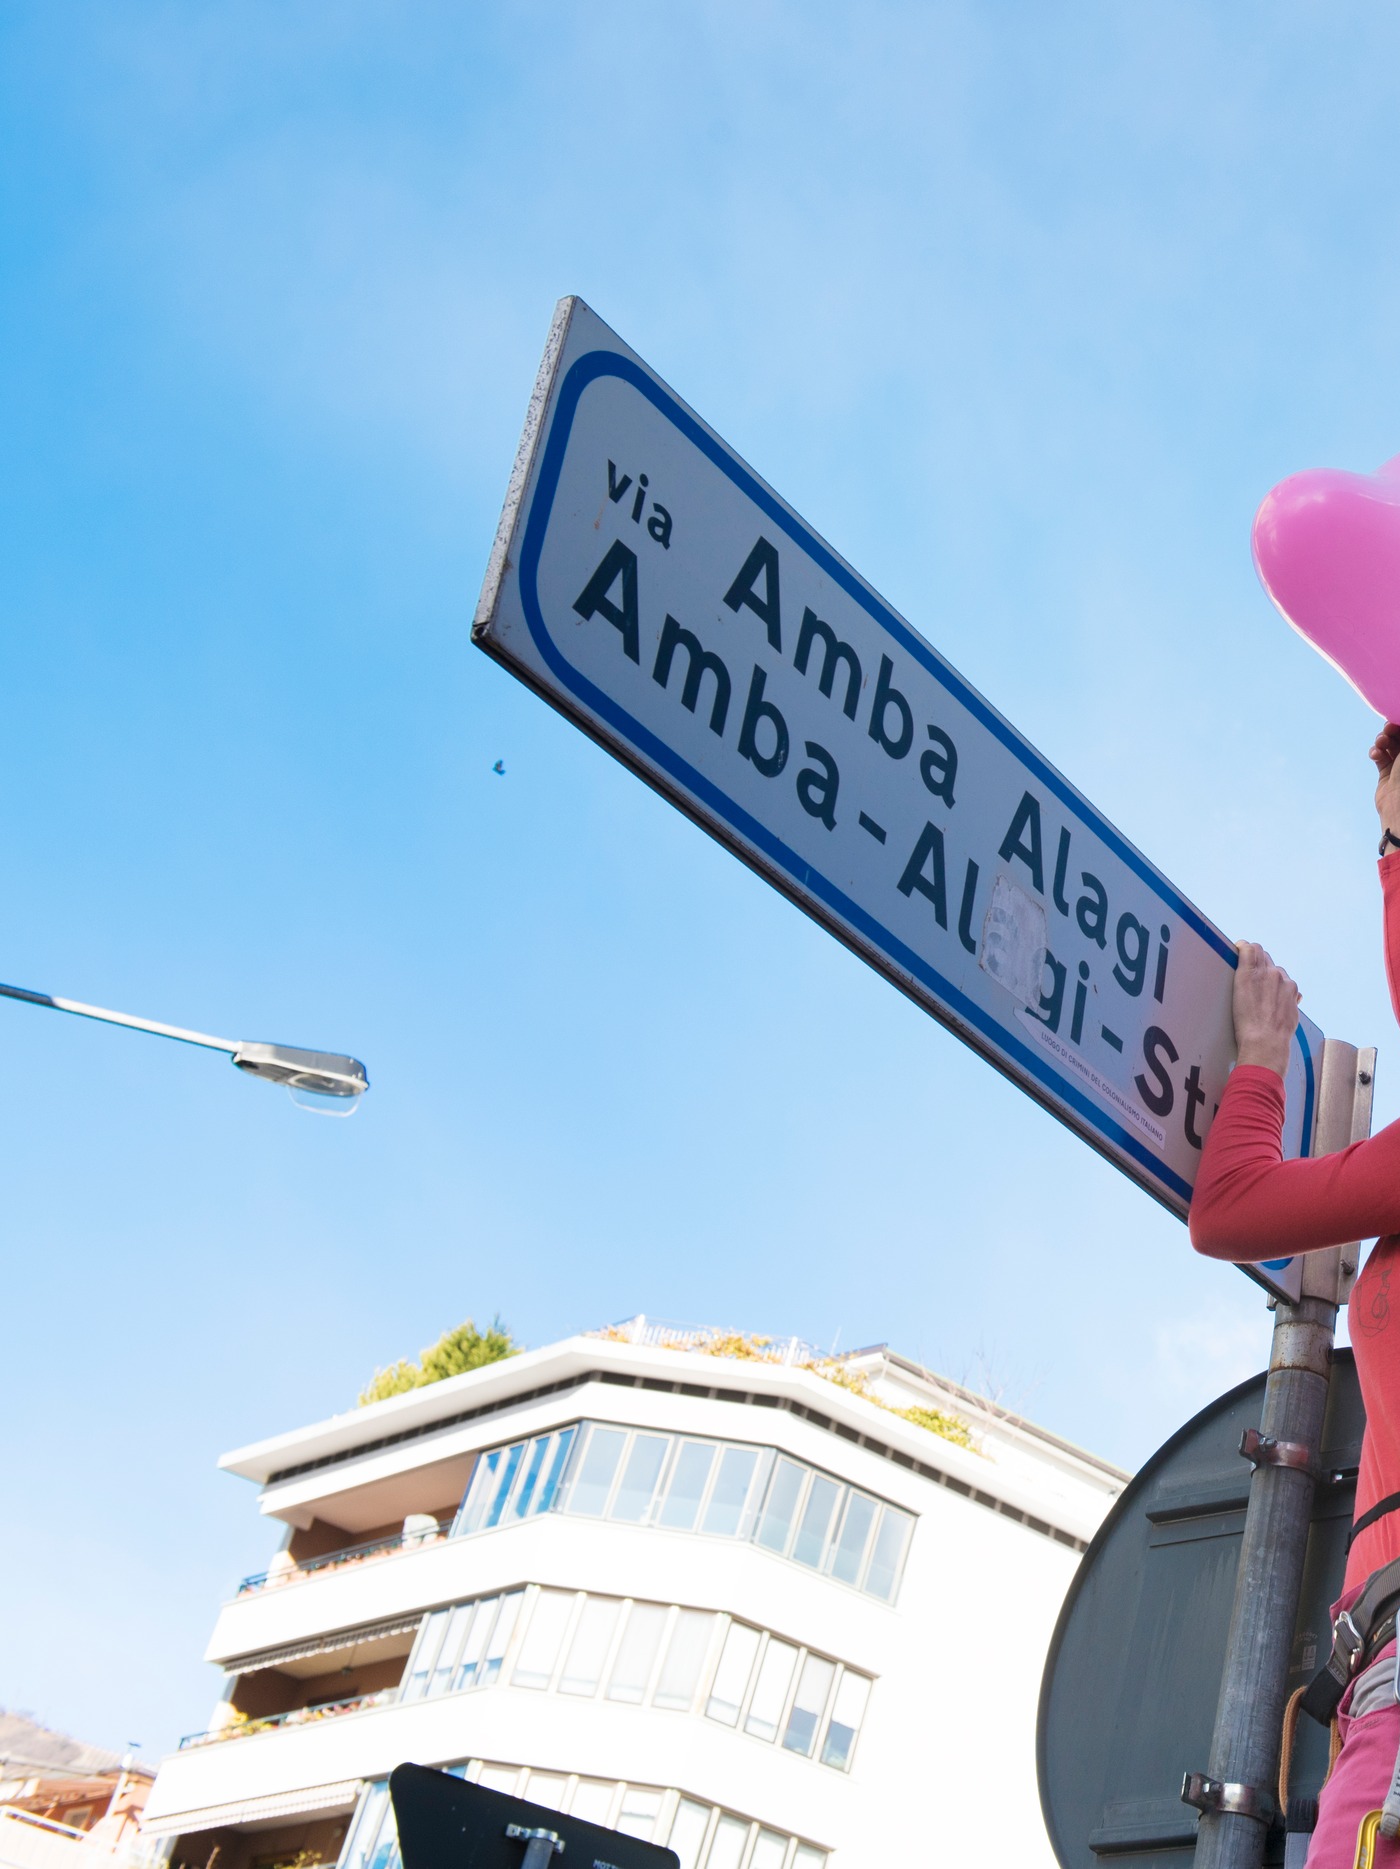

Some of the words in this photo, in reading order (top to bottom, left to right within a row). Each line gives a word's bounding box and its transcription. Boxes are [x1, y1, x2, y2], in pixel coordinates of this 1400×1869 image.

[572, 539, 1219, 1150] Amba-Algi-St
[608, 458, 673, 550] via
[722, 536, 958, 810] Amba
[997, 790, 1171, 1004] Alagi
[1041, 1031, 1060, 1052] LUOGO
[1061, 1048, 1068, 1059] DI
[1068, 1054, 1090, 1077] CRIMINI
[1090, 1073, 1101, 1087] DEL
[1101, 1083, 1140, 1121] COLONIALISMO
[1140, 1117, 1163, 1141] ITALIANO
